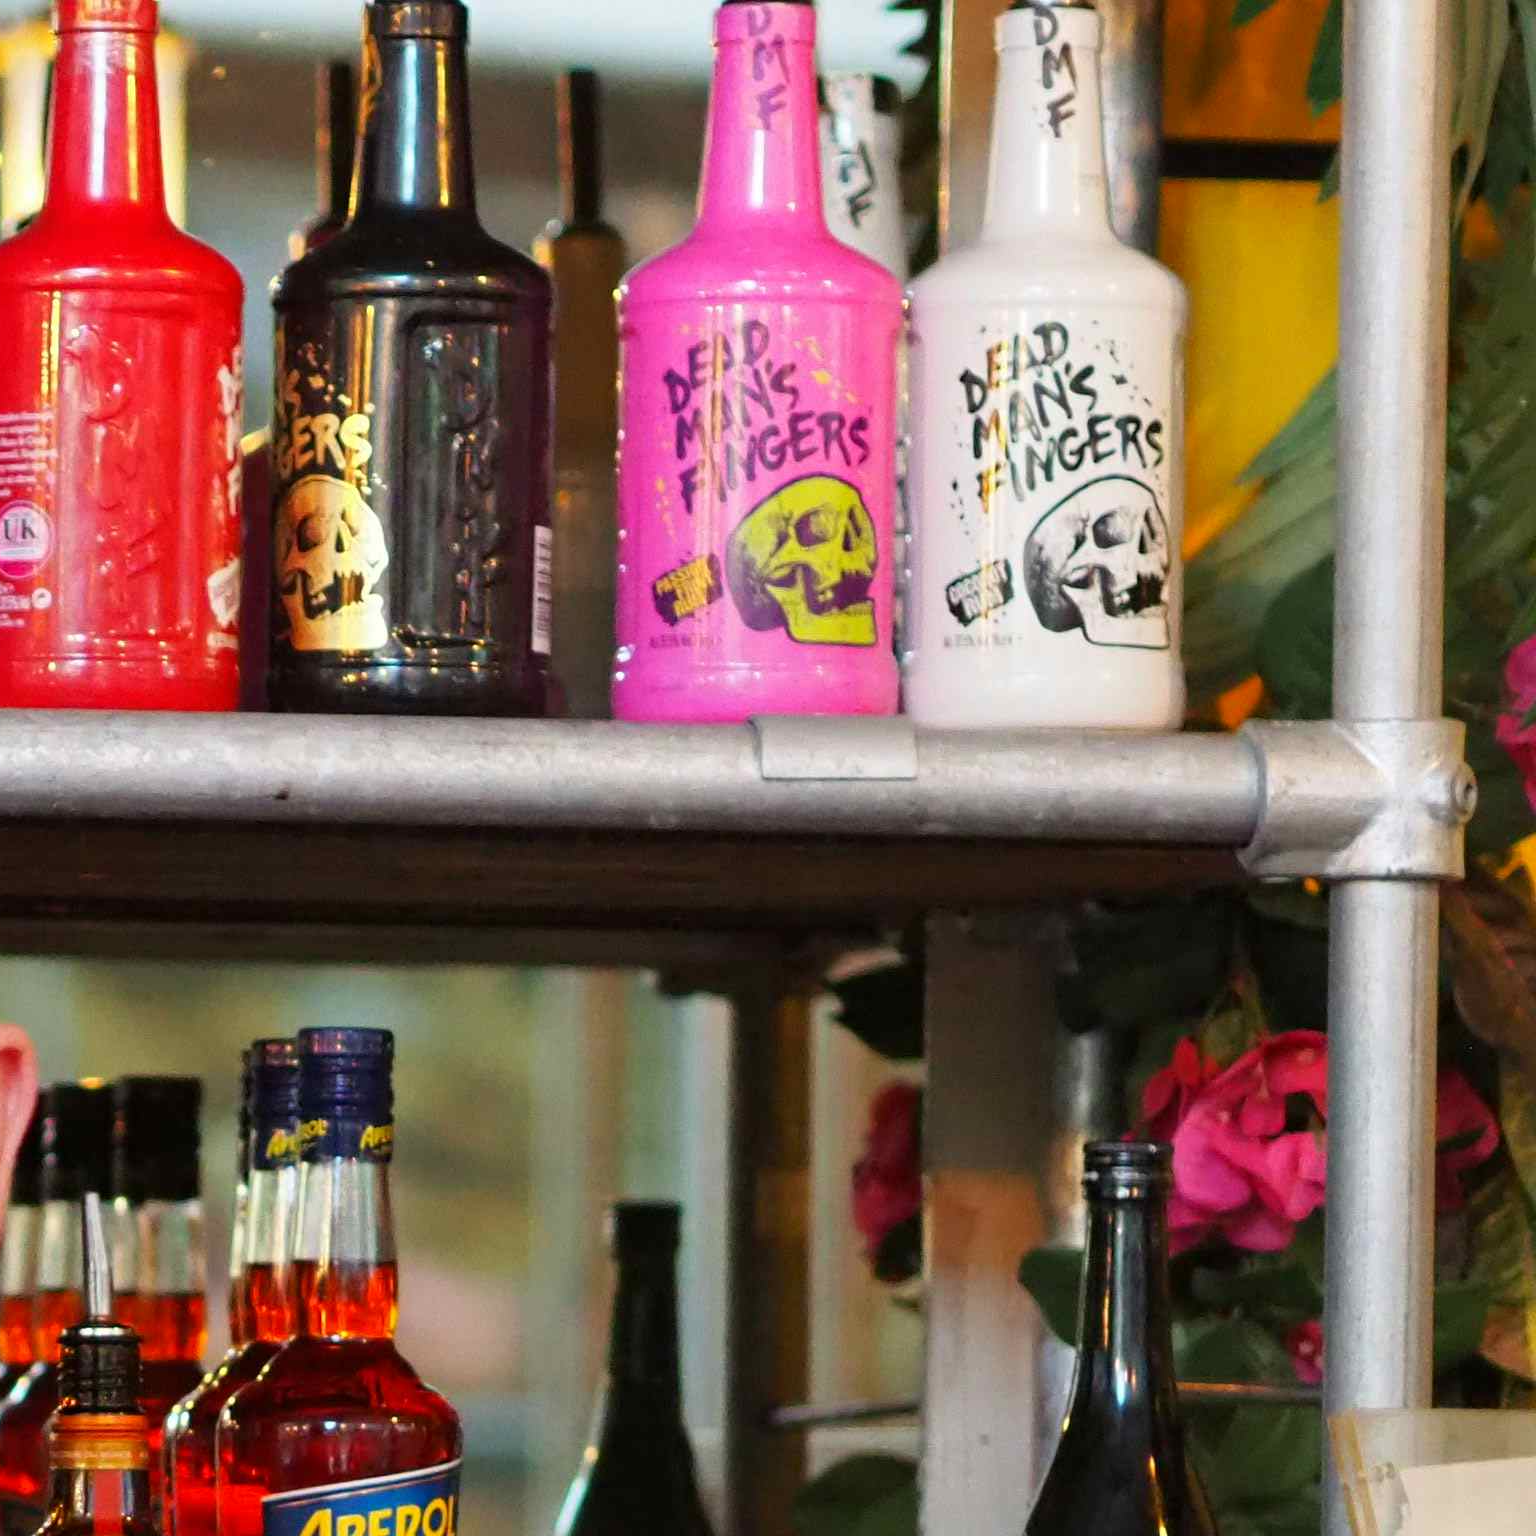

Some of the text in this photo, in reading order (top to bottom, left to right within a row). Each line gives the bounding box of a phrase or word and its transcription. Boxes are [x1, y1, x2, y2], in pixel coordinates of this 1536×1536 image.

[958, 320, 1070, 415] DEAD
[972, 362, 1098, 461] MAN'S
[975, 413, 1164, 516] FINGERS
[3, 518, 38, 541] UK
